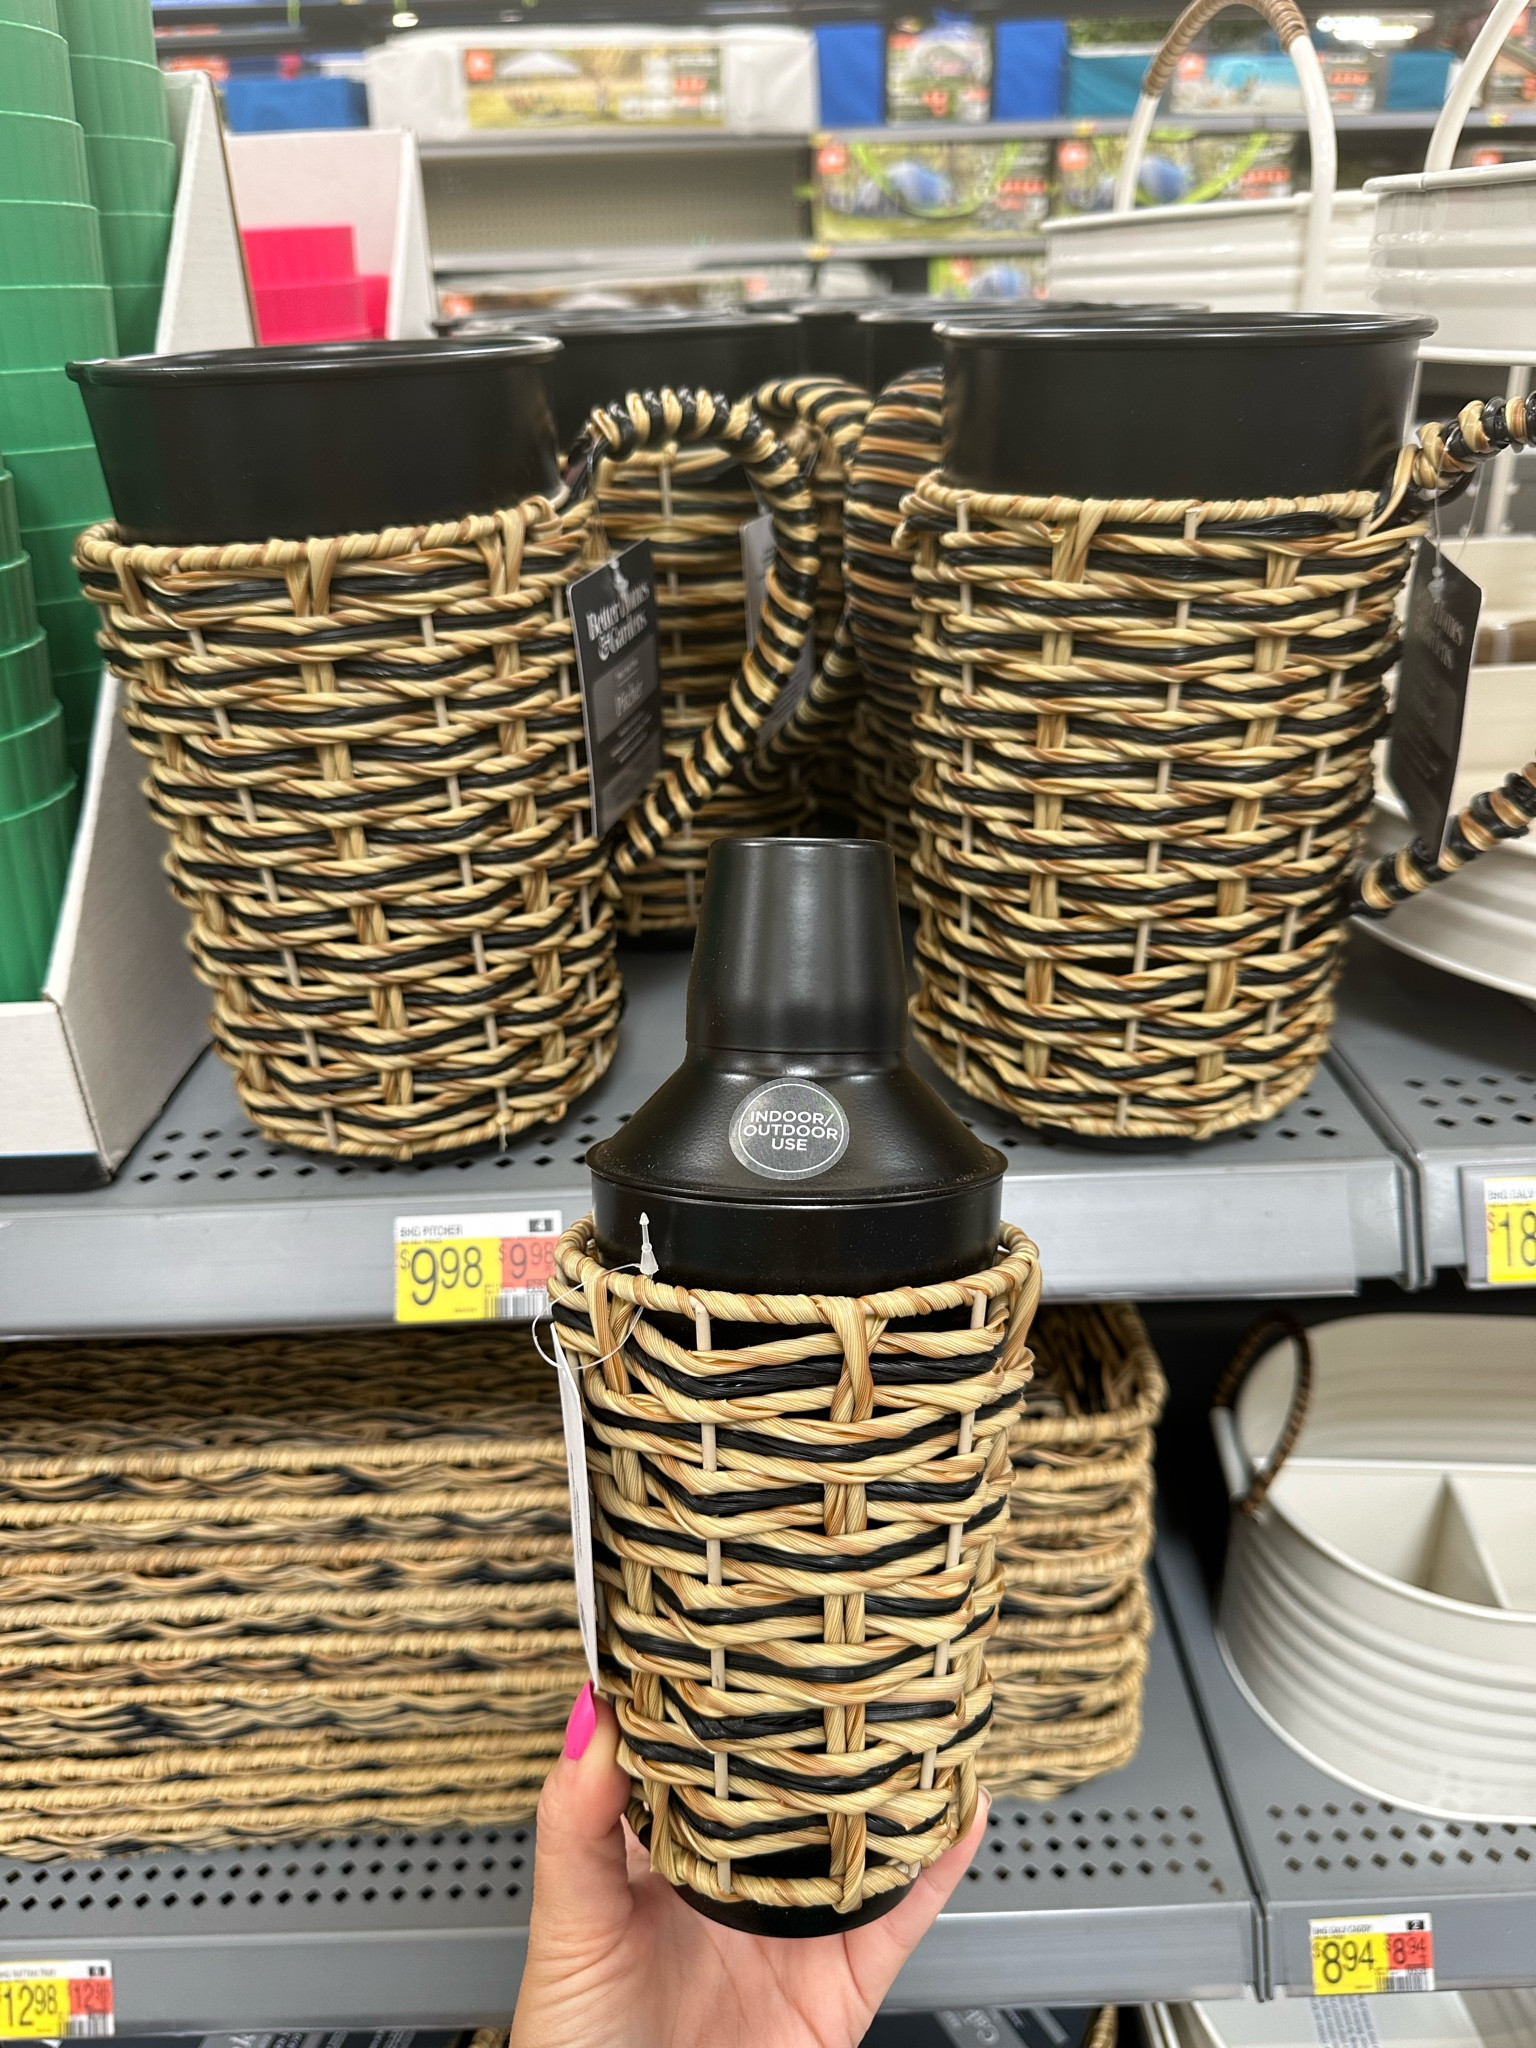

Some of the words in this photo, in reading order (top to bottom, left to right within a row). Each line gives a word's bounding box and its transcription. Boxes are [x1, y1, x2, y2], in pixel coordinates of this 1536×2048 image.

[586, 601, 620, 641] Better
[609, 613, 649, 654] Gardens
[750, 1110, 834, 1127] INDOOR/
[743, 1123, 839, 1141] OUTDOOR
[771, 1137, 808, 1151] USE
[423, 1224, 463, 1237] PITCHER
[1411, 1920, 1420, 1930] 2
